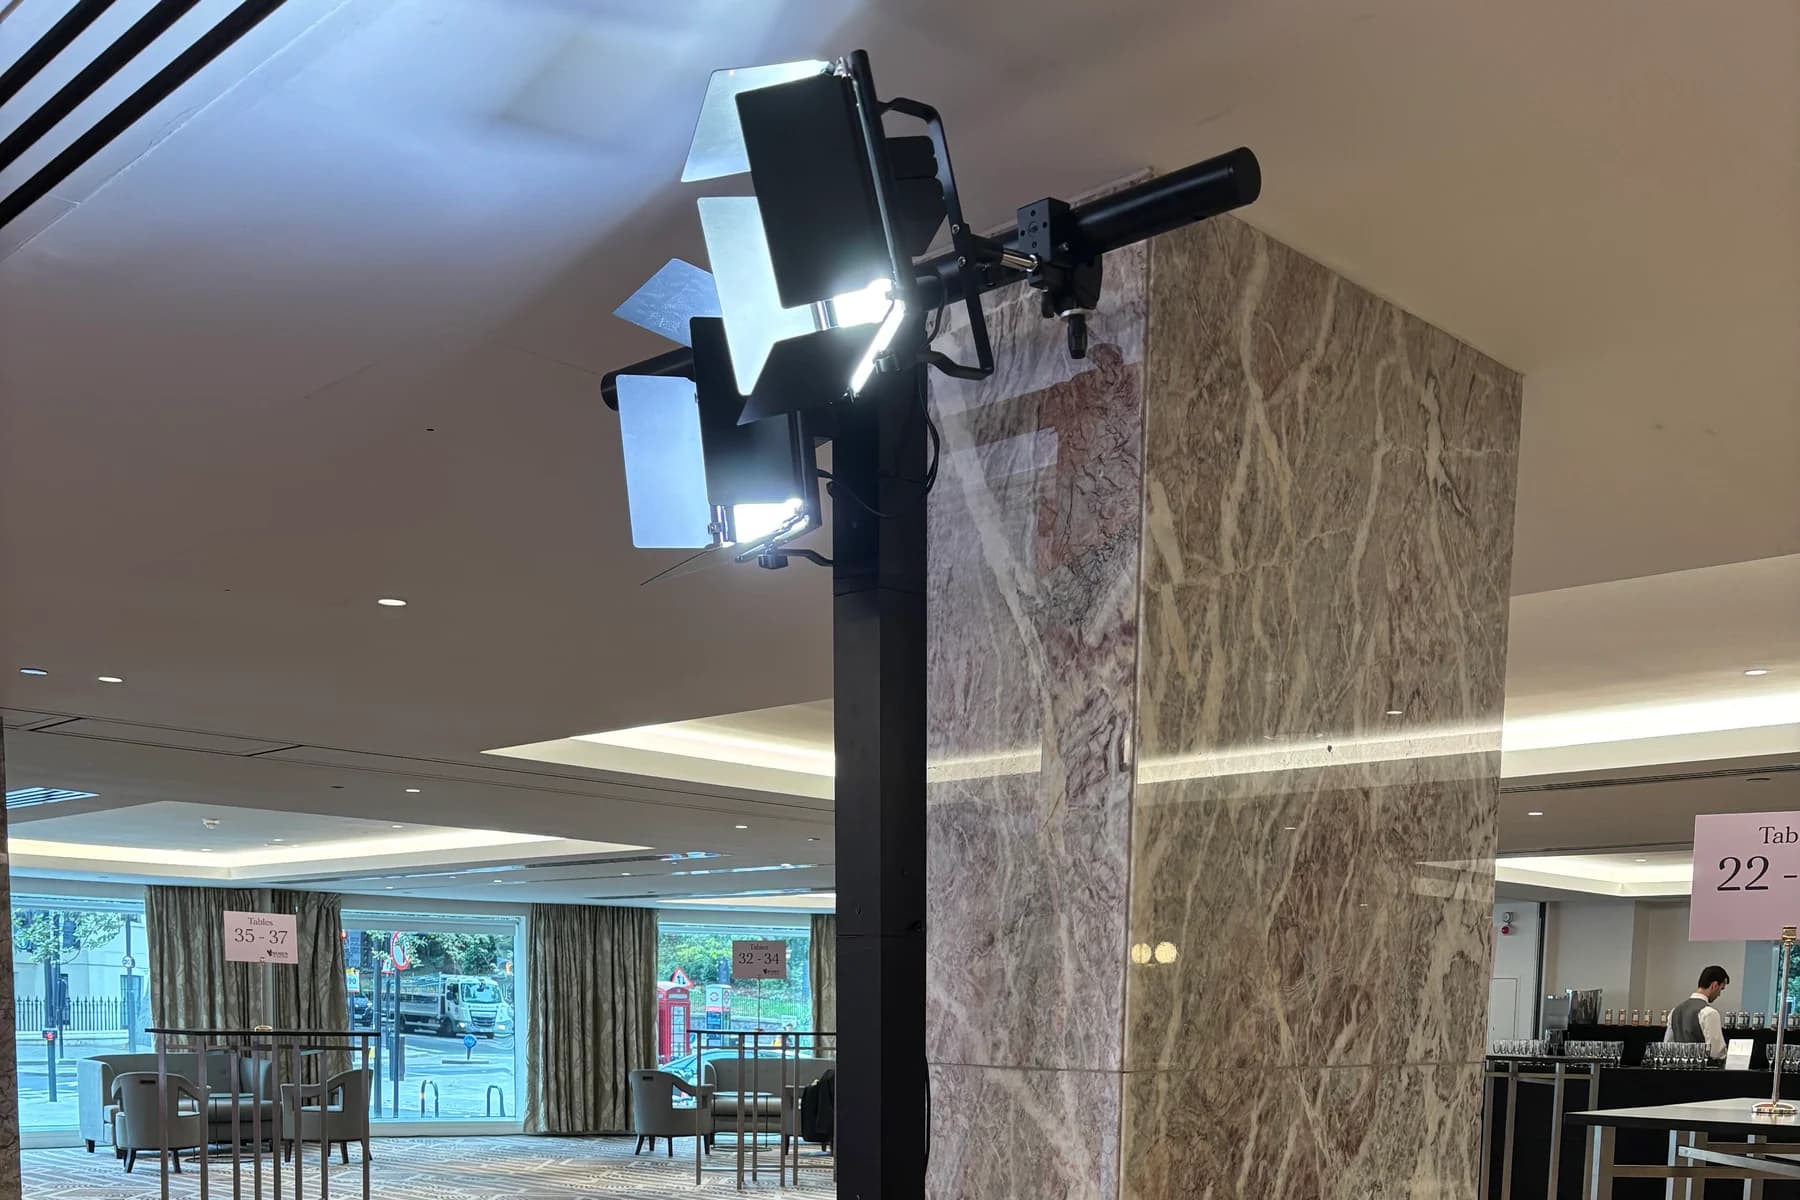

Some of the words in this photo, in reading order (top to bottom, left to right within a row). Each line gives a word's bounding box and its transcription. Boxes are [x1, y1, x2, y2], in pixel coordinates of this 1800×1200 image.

[1717, 855, 1770, 891] 22
[234, 927, 255, 943] 35
[269, 929, 288, 945] 37
[738, 952, 754, 965] 32
[764, 952, 779, 965] 34
